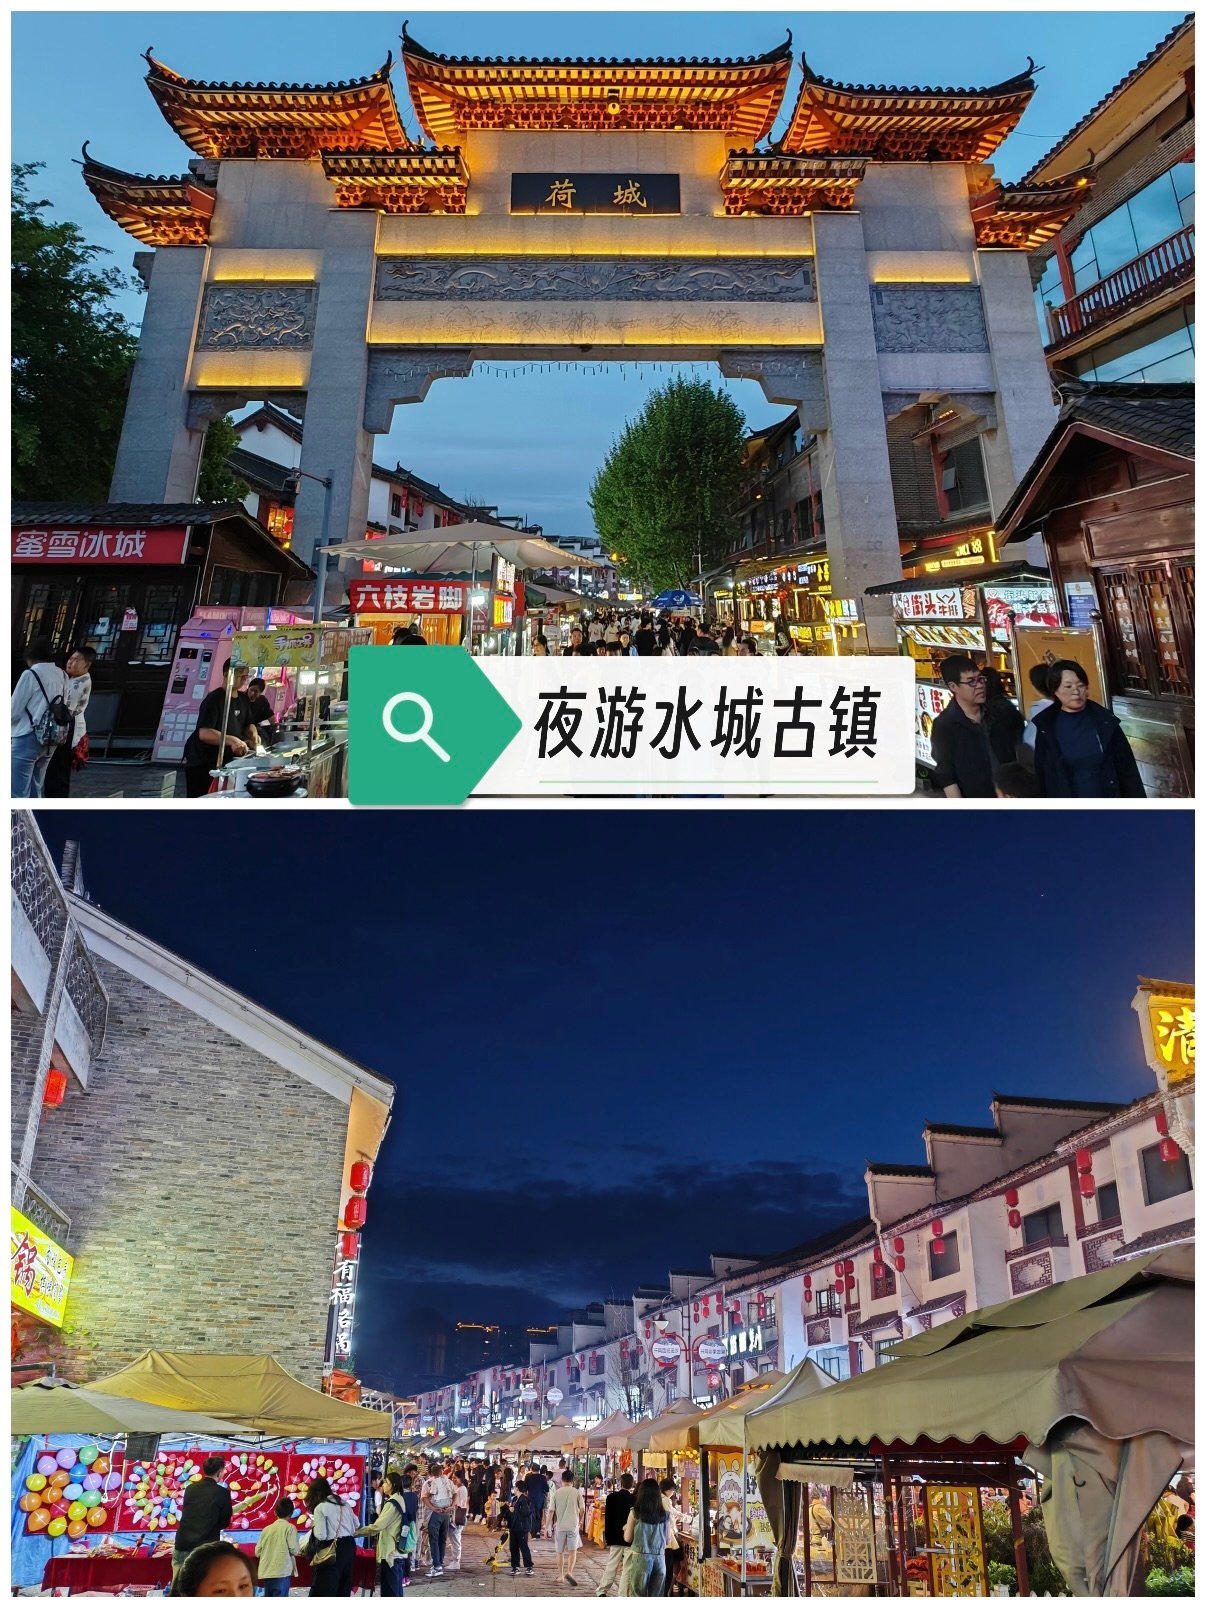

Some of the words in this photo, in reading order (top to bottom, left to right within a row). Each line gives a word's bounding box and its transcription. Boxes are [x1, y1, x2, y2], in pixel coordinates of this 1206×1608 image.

[545, 179, 647, 209] 荷城
[12, 530, 147, 559] 蜜雪冰城
[357, 585, 489, 611] 六枝岩脚
